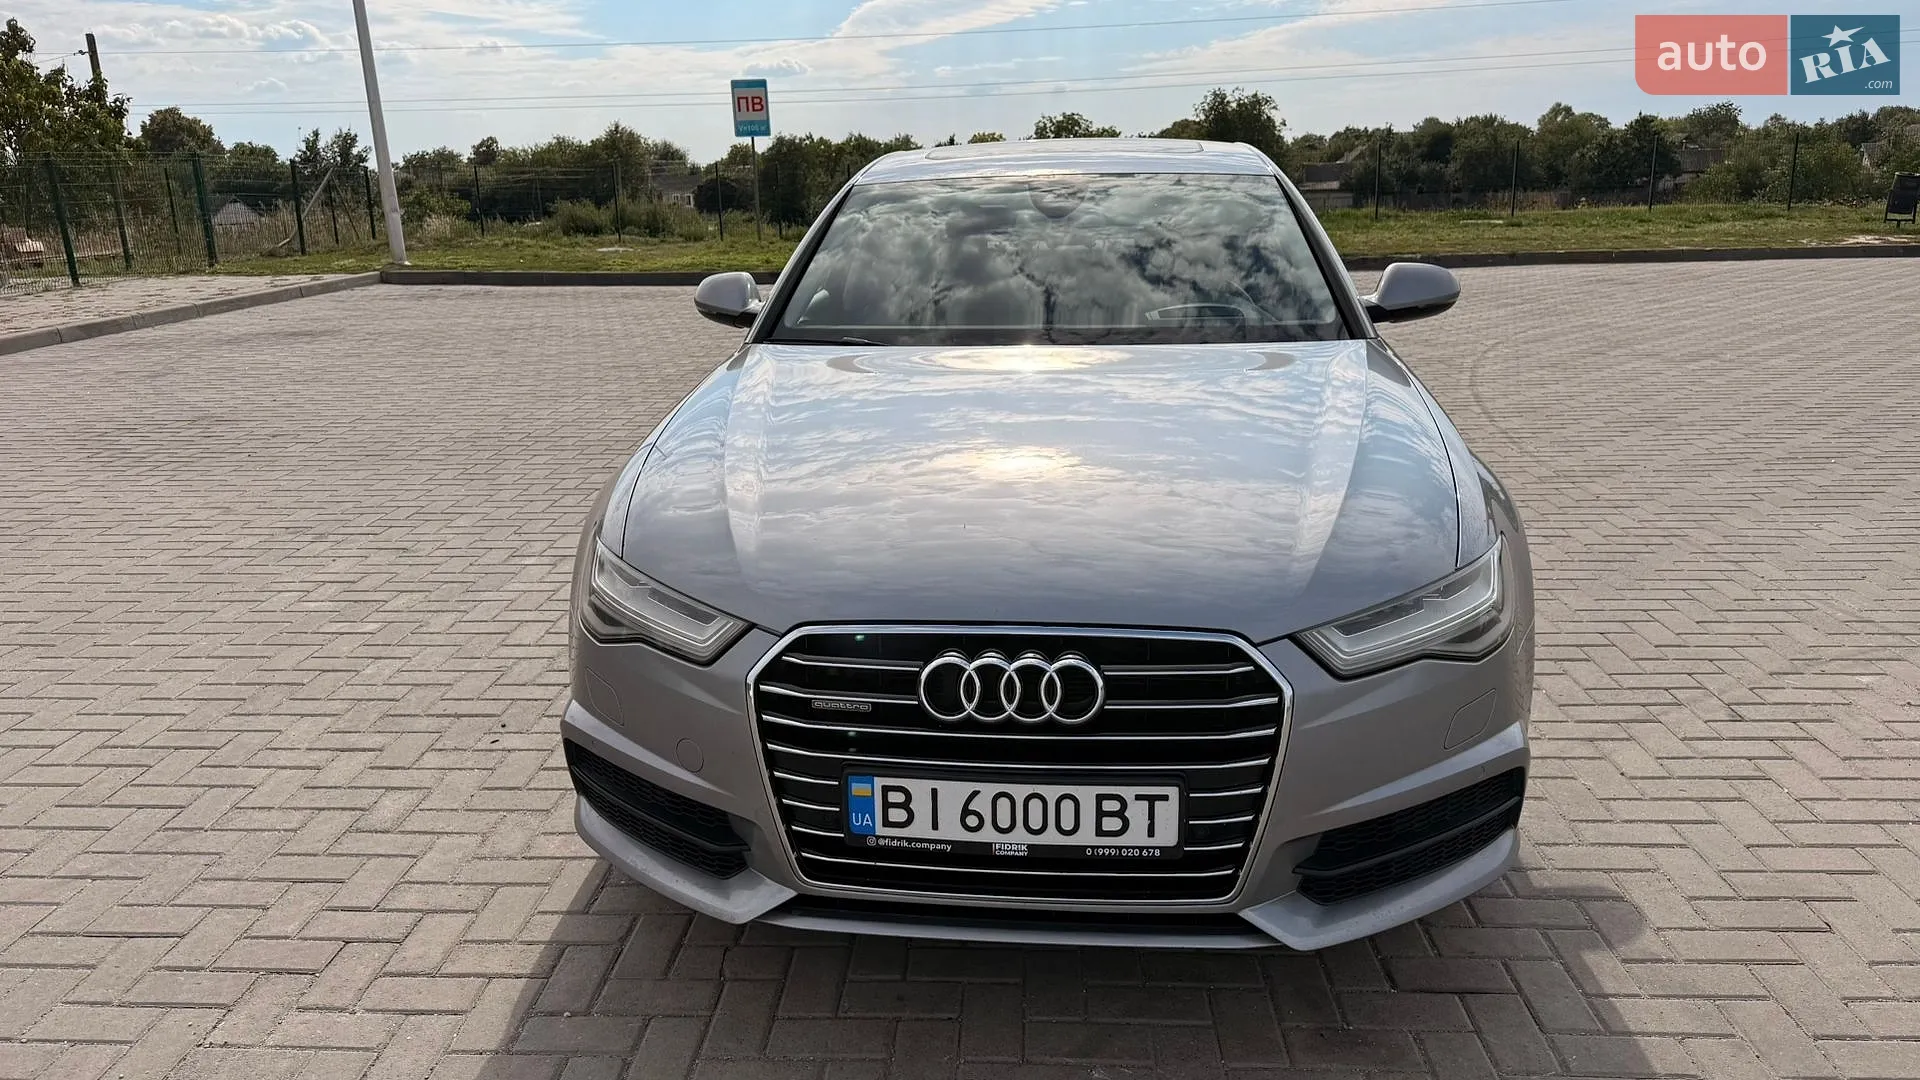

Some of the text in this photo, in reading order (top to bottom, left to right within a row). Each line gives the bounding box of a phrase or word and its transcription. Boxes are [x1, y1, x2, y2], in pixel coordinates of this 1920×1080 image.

[737, 96, 764, 112] ПВ
[814, 701, 869, 710] quattro
[881, 784, 1170, 838] BI 6000 BT
[852, 813, 873, 827] UA
[877, 838, 952, 852] @fidrik.company
[995, 843, 1028, 851] FIDRIK
[1121, 848, 1140, 857] 020
[1142, 848, 1161, 857] 678
